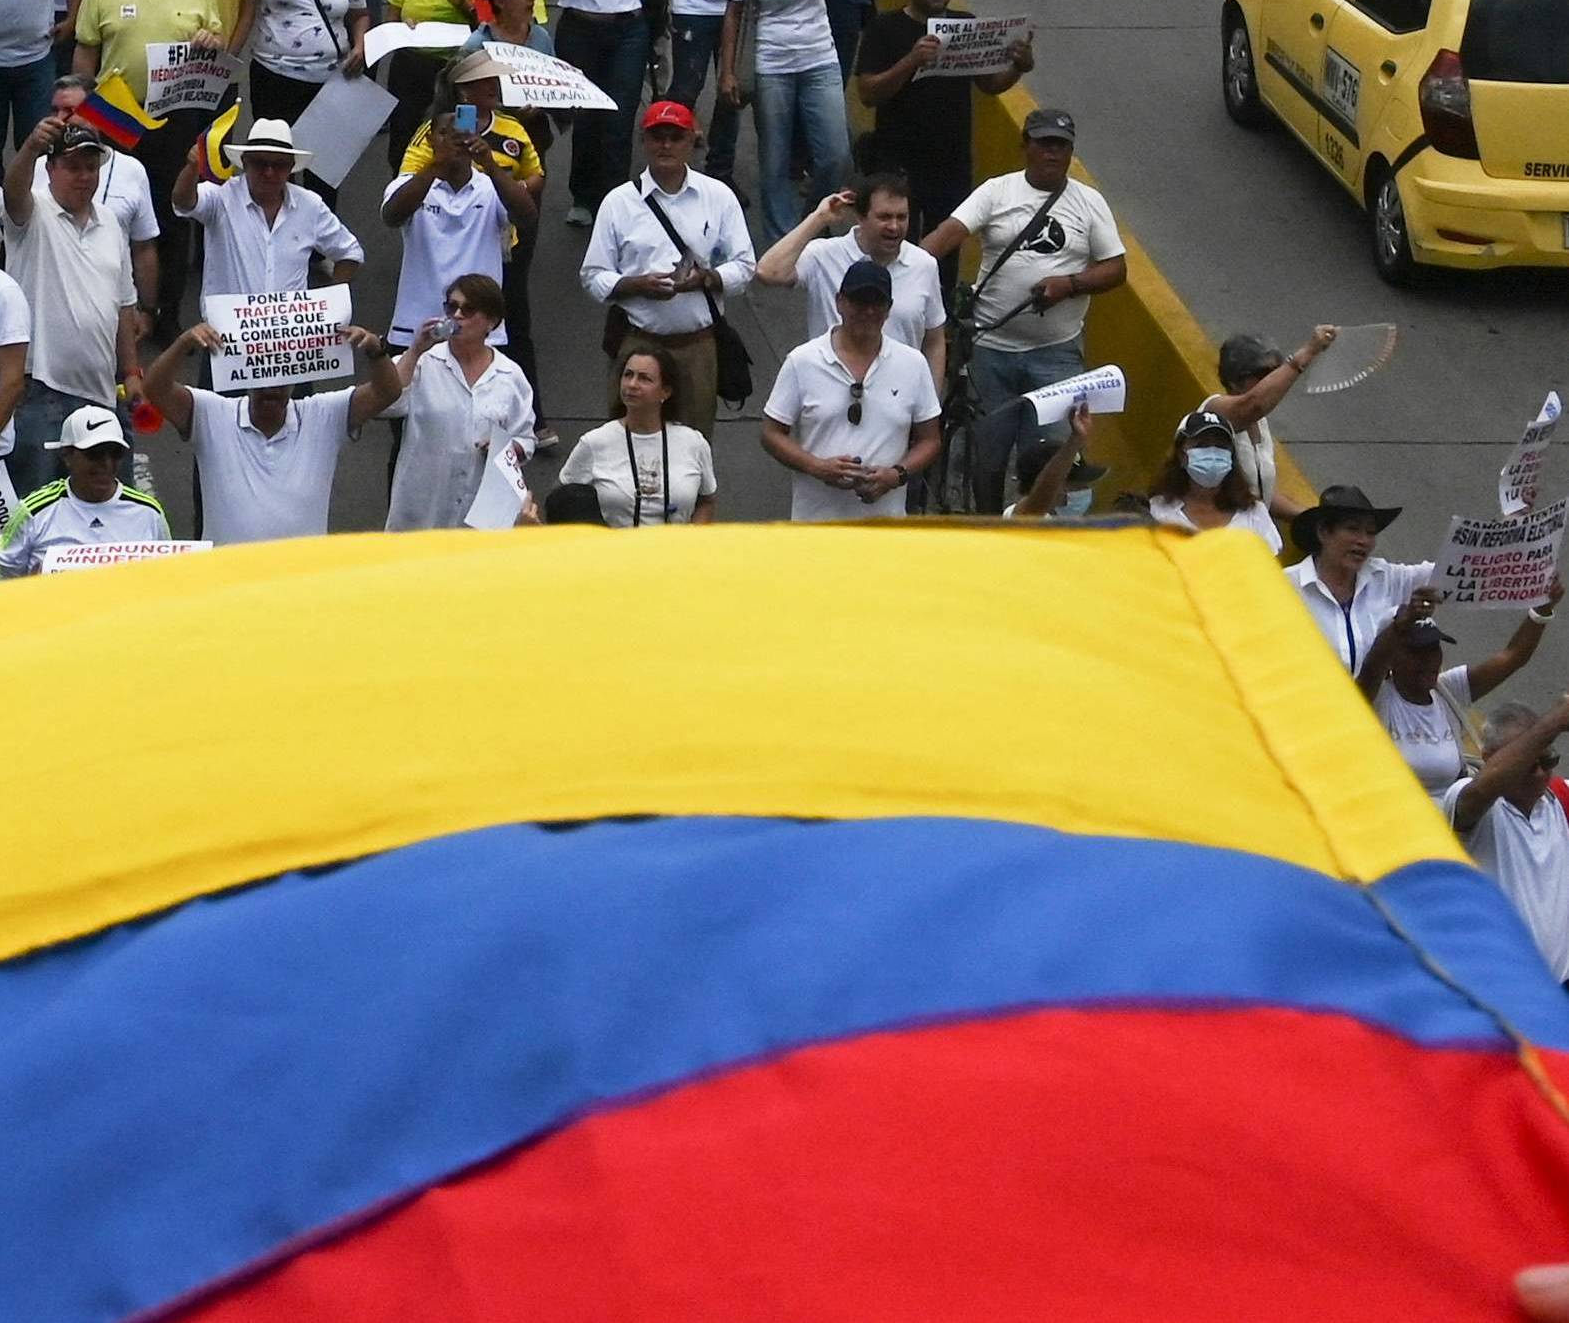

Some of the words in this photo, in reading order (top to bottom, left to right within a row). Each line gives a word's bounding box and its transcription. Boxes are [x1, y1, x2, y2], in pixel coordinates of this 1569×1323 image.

[935, 22, 963, 35] PONE
[963, 22, 976, 34] AL
[185, 64, 232, 81] CUBANOS
[247, 293, 283, 307] PONE
[294, 291, 312, 303] AL
[233, 299, 328, 319] TRAFICANTE
[239, 315, 289, 330] ANTES
[294, 312, 326, 325] QUE
[220, 331, 238, 344] AL
[241, 322, 343, 342] COMERCIANTE
[224, 345, 243, 357] AL
[245, 334, 343, 355] DELINCUENTE
[245, 353, 292, 368] ANTES
[295, 349, 324, 362] QUE
[230, 369, 249, 382] AL
[251, 358, 340, 380] EMPRESARIO
[1462, 552, 1522, 566] PELIGRO
[1526, 543, 1554, 562] PARA
[1446, 564, 1468, 577] LA
[1457, 579, 1476, 591] LA
[1481, 573, 1546, 590] LIBERTAD
[1442, 590, 1452, 601] Y
[1456, 591, 1475, 603] LA
